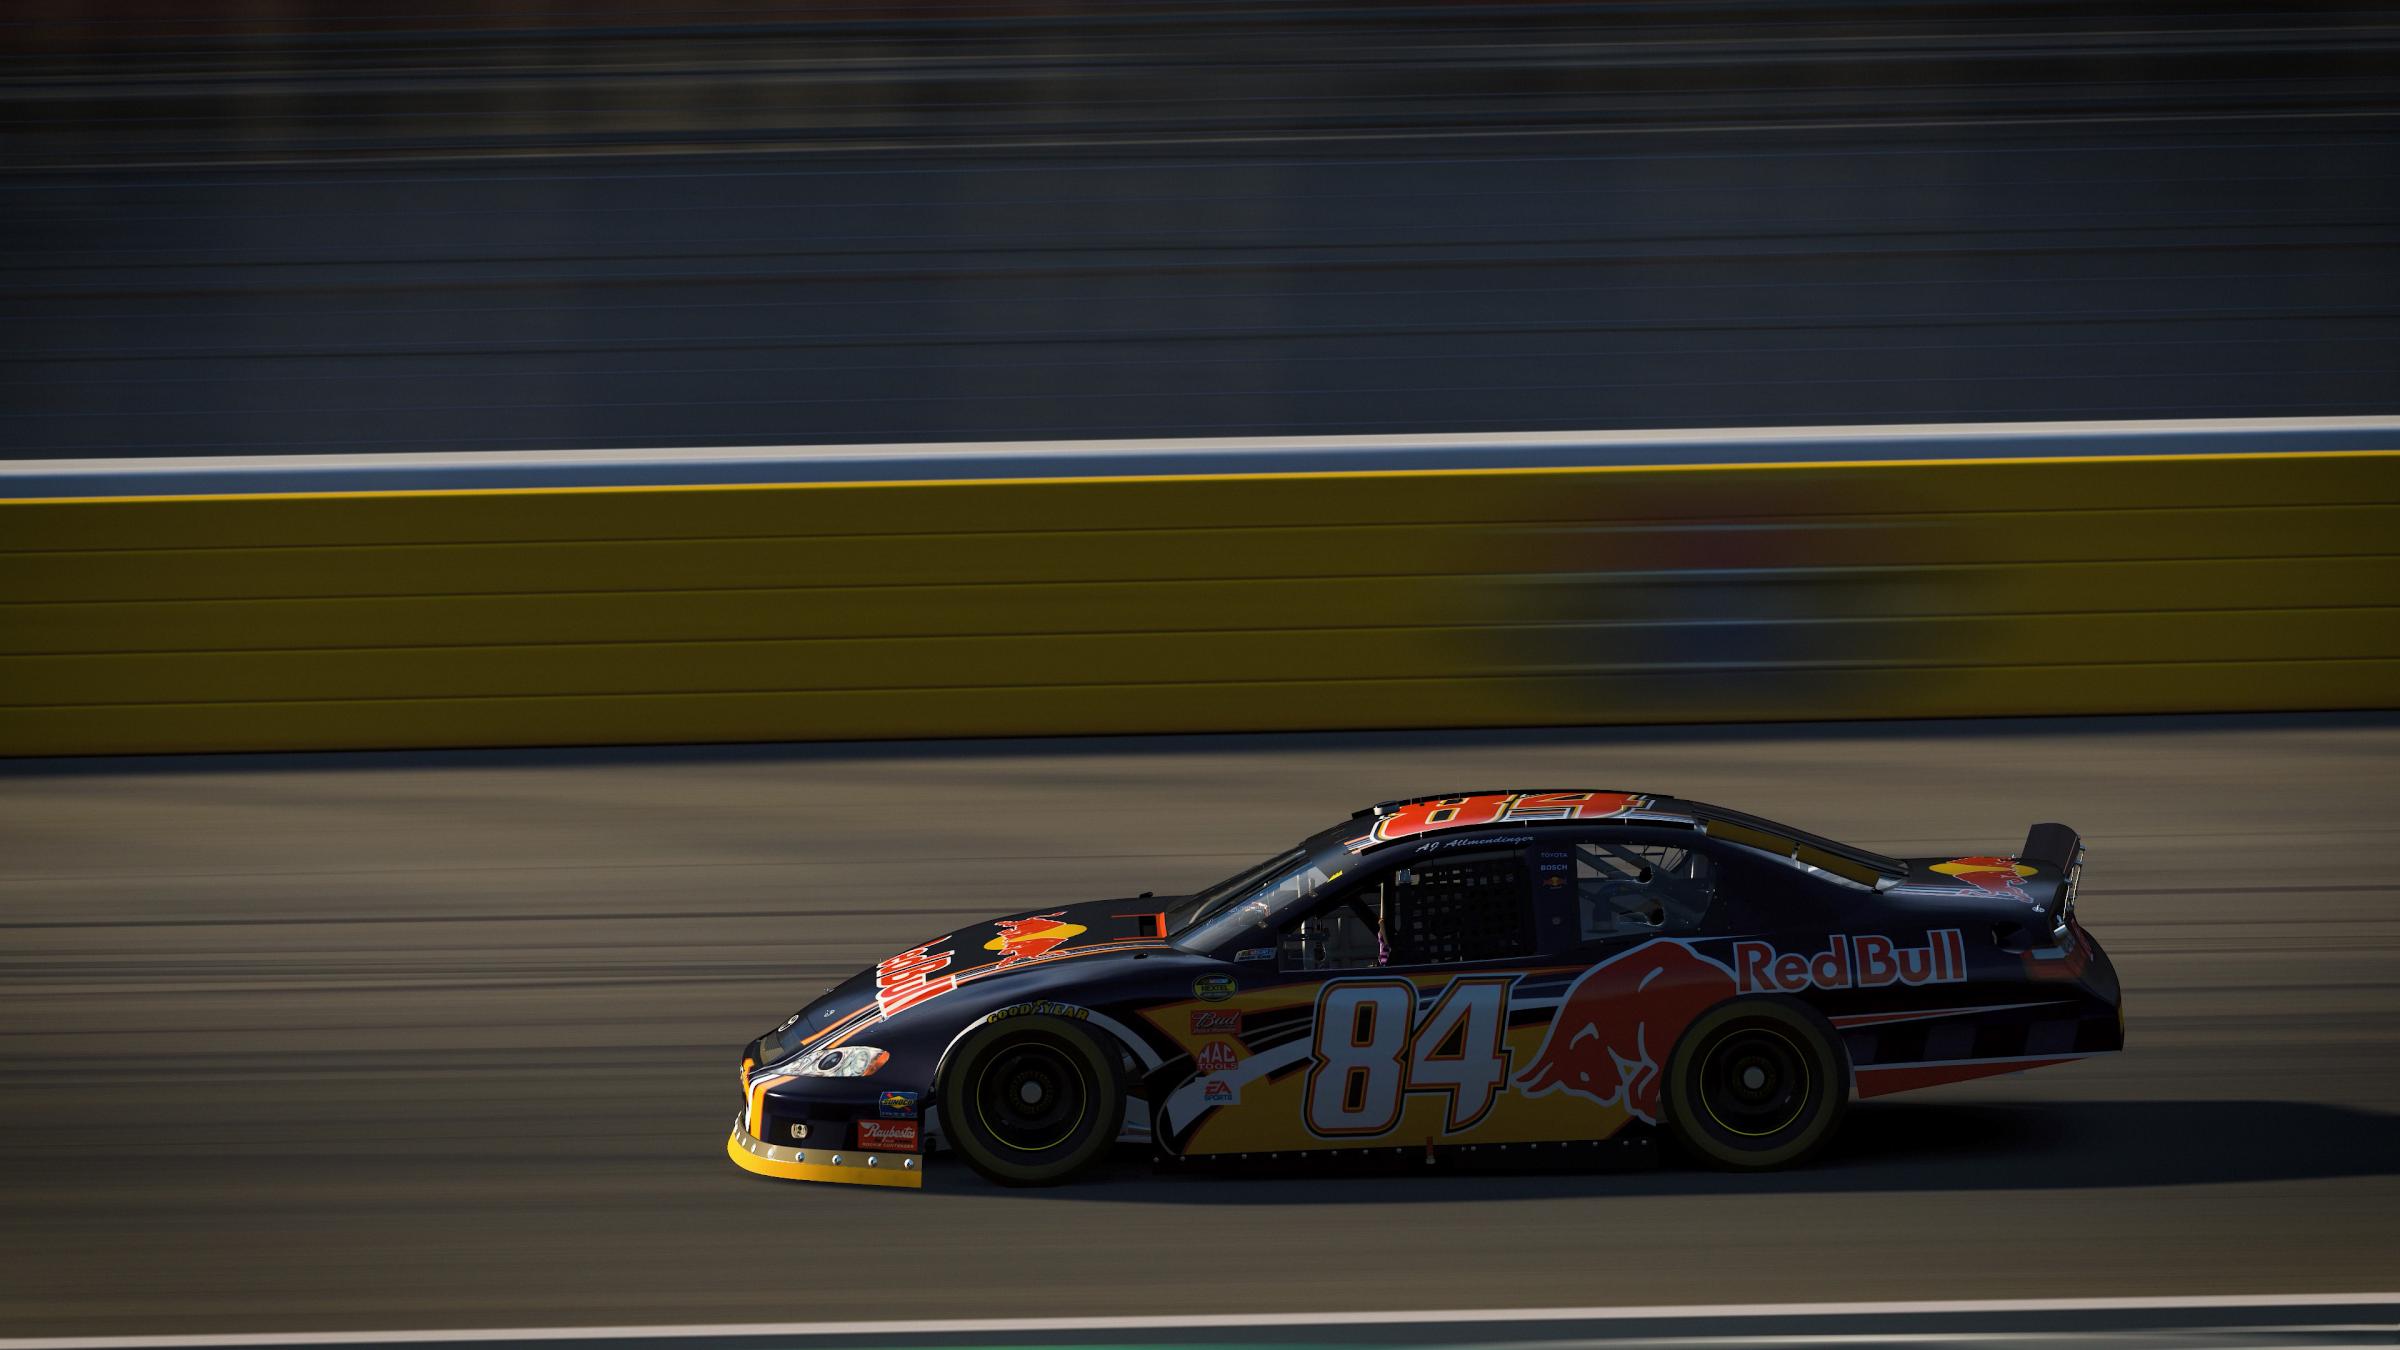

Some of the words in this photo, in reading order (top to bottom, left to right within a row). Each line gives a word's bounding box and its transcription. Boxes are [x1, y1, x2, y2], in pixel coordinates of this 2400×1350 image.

[1368, 792, 1654, 842] 84
[1415, 841, 1440, 853] AJ
[1443, 835, 1534, 848] Allmendinger
[1733, 934, 1852, 995] Red
[1852, 928, 1967, 988] Bull
[876, 956, 958, 1022] Bull
[987, 1002, 1089, 1022] GOODYEAR
[1192, 1011, 1240, 1028] Bud
[1198, 1041, 1236, 1063] MAC
[1303, 974, 1524, 1140] 84
[1205, 1081, 1232, 1094] EA
